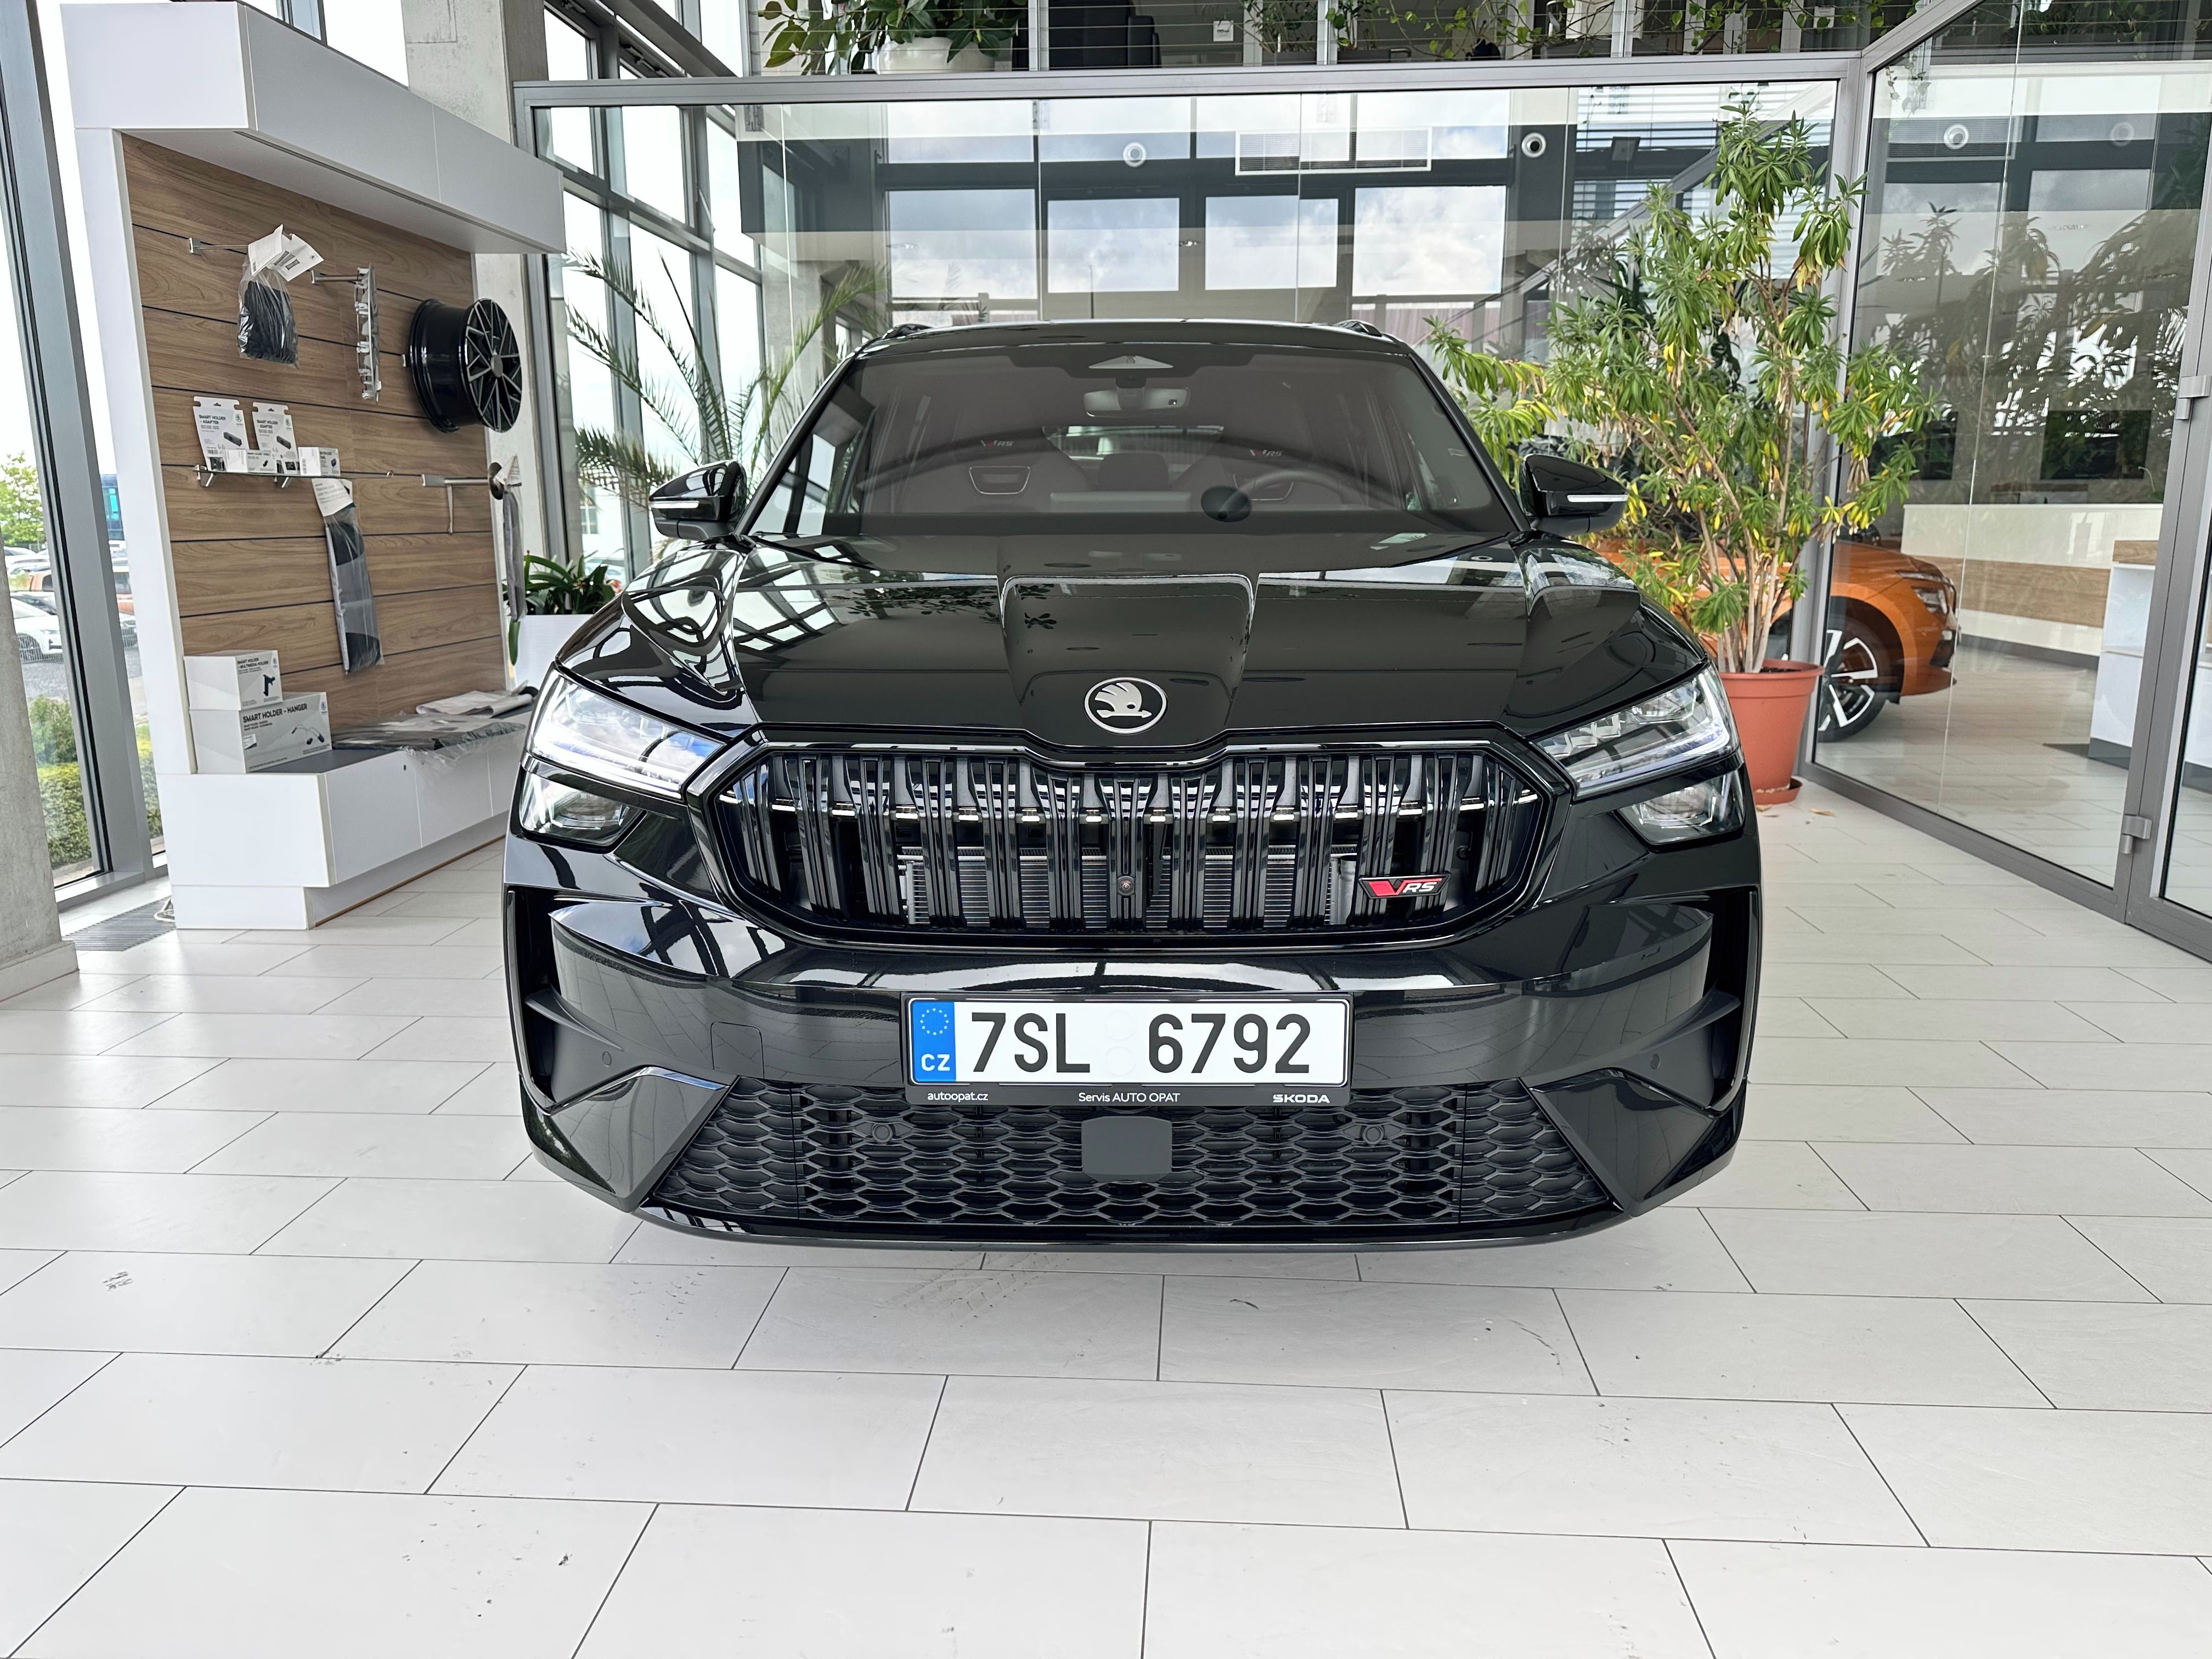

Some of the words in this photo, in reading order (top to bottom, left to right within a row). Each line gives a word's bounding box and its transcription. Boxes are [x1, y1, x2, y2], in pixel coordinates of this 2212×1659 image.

[243, 713, 261, 723] SMART
[262, 708, 283, 719] HOLDER
[287, 703, 308, 713] HANGER
[972, 1012, 1090, 1073] 7SL
[1149, 1013, 1311, 1074] 6792
[921, 1053, 950, 1071] CZ
[927, 1092, 989, 1103] autoopat.cz
[1079, 1092, 1110, 1102] Servis
[1112, 1093, 1147, 1102] AUTO
[1149, 1093, 1181, 1102] OPAT
